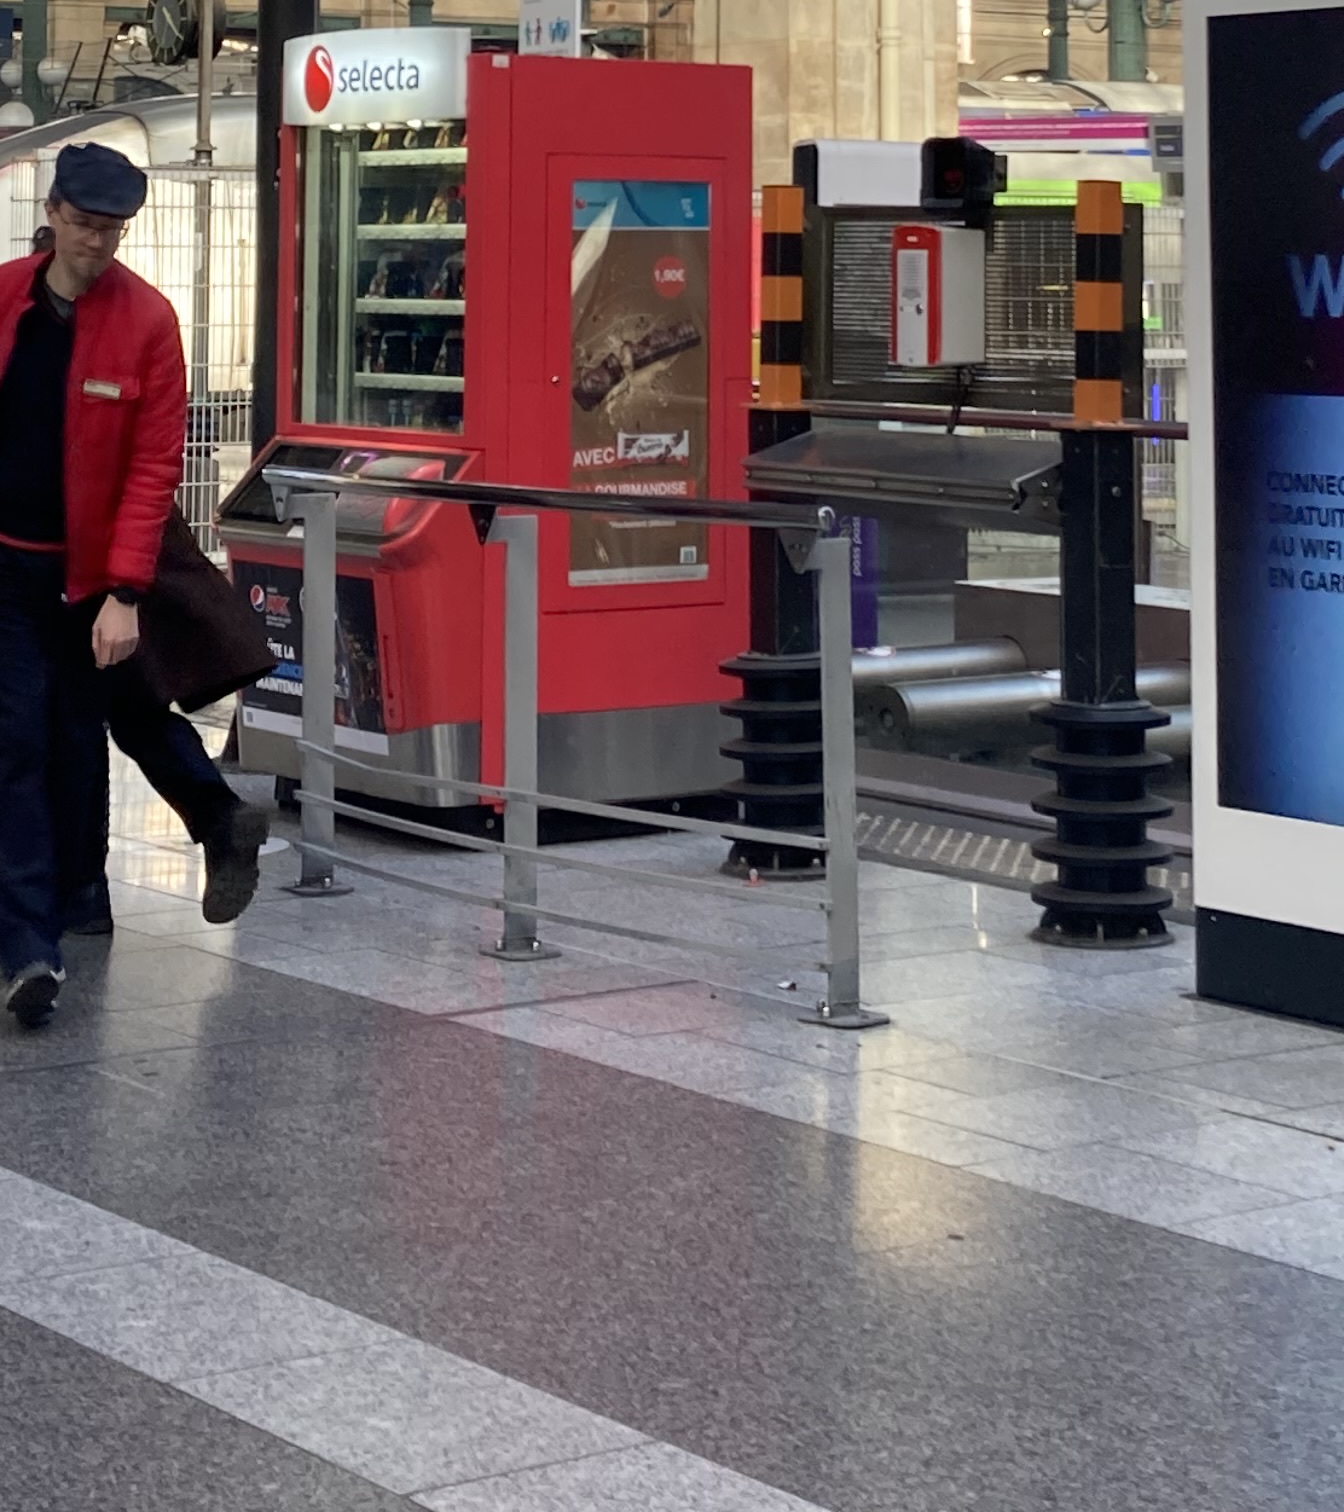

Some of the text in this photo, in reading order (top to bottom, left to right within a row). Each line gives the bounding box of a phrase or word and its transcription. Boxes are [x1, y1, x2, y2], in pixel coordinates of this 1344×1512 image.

[337, 57, 421, 93] selecta
[572, 446, 616, 468] AVEC
[1267, 535, 1296, 558] AU
[1300, 537, 1342, 562] WIFI
[1267, 566, 1295, 590] EN
